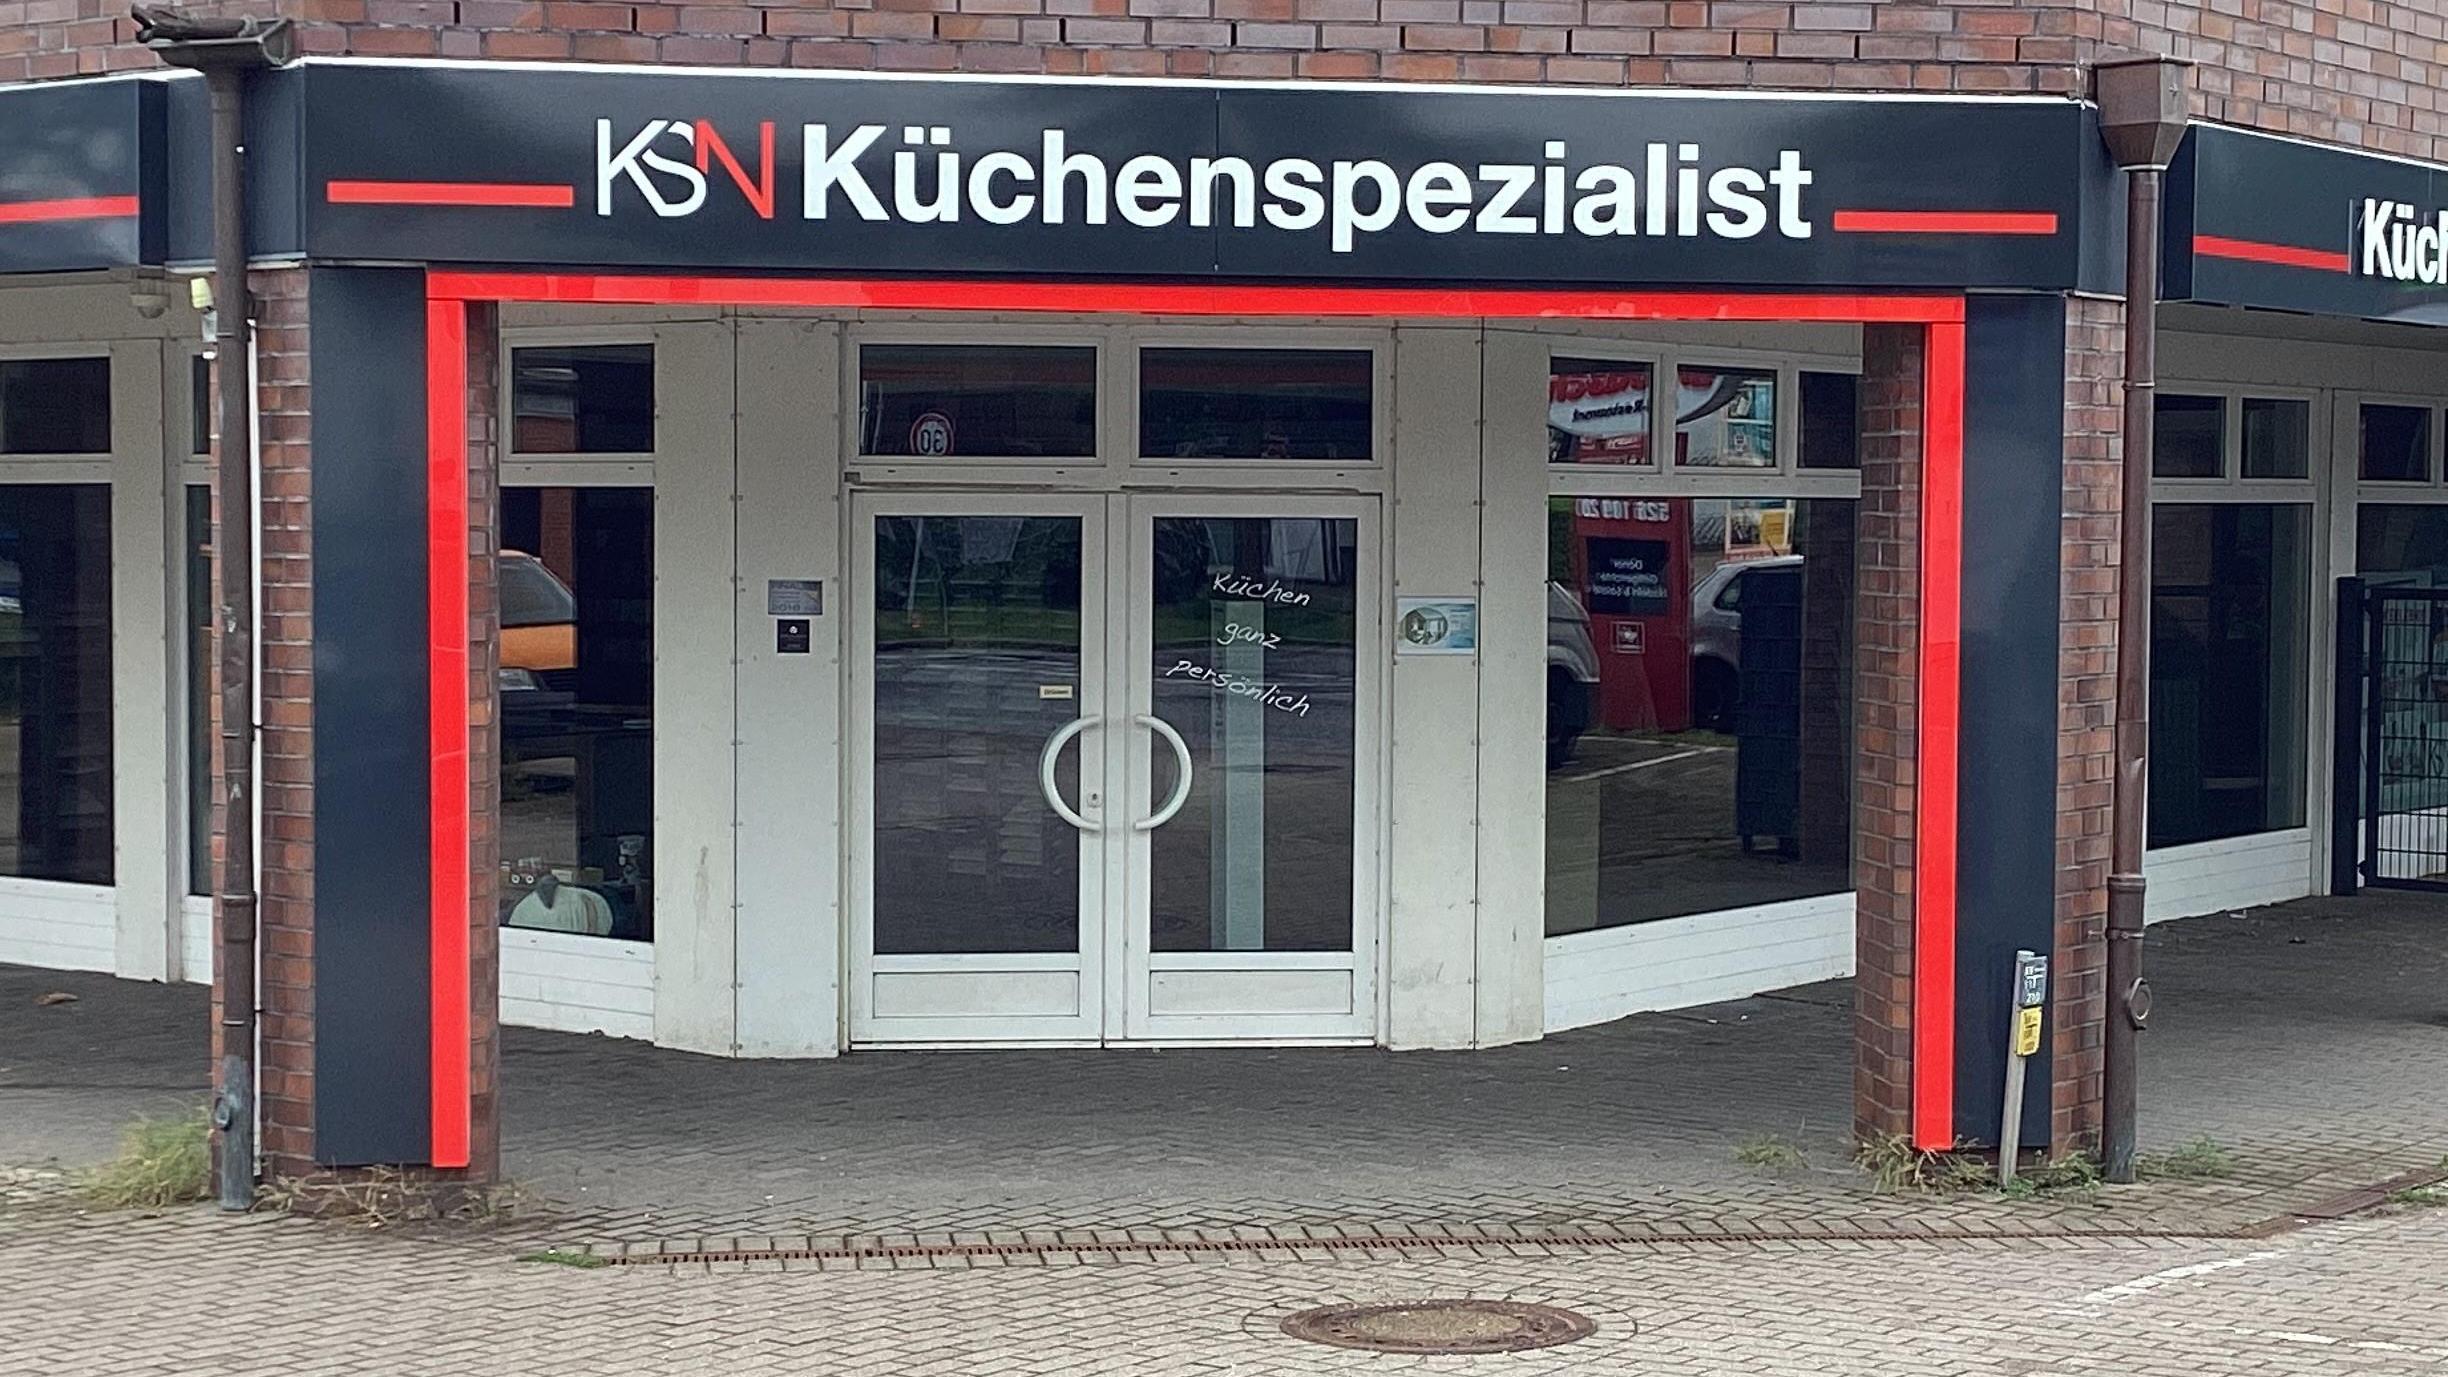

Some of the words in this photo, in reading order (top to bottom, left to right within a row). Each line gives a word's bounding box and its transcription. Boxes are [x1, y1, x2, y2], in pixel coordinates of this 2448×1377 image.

[597, 118, 776, 219] KSN
[803, 124, 1812, 252] Küchenspezialist
[1213, 573, 1310, 606] Küchen
[1217, 623, 1281, 649] ganz
[1166, 660, 1310, 717] persönlich
